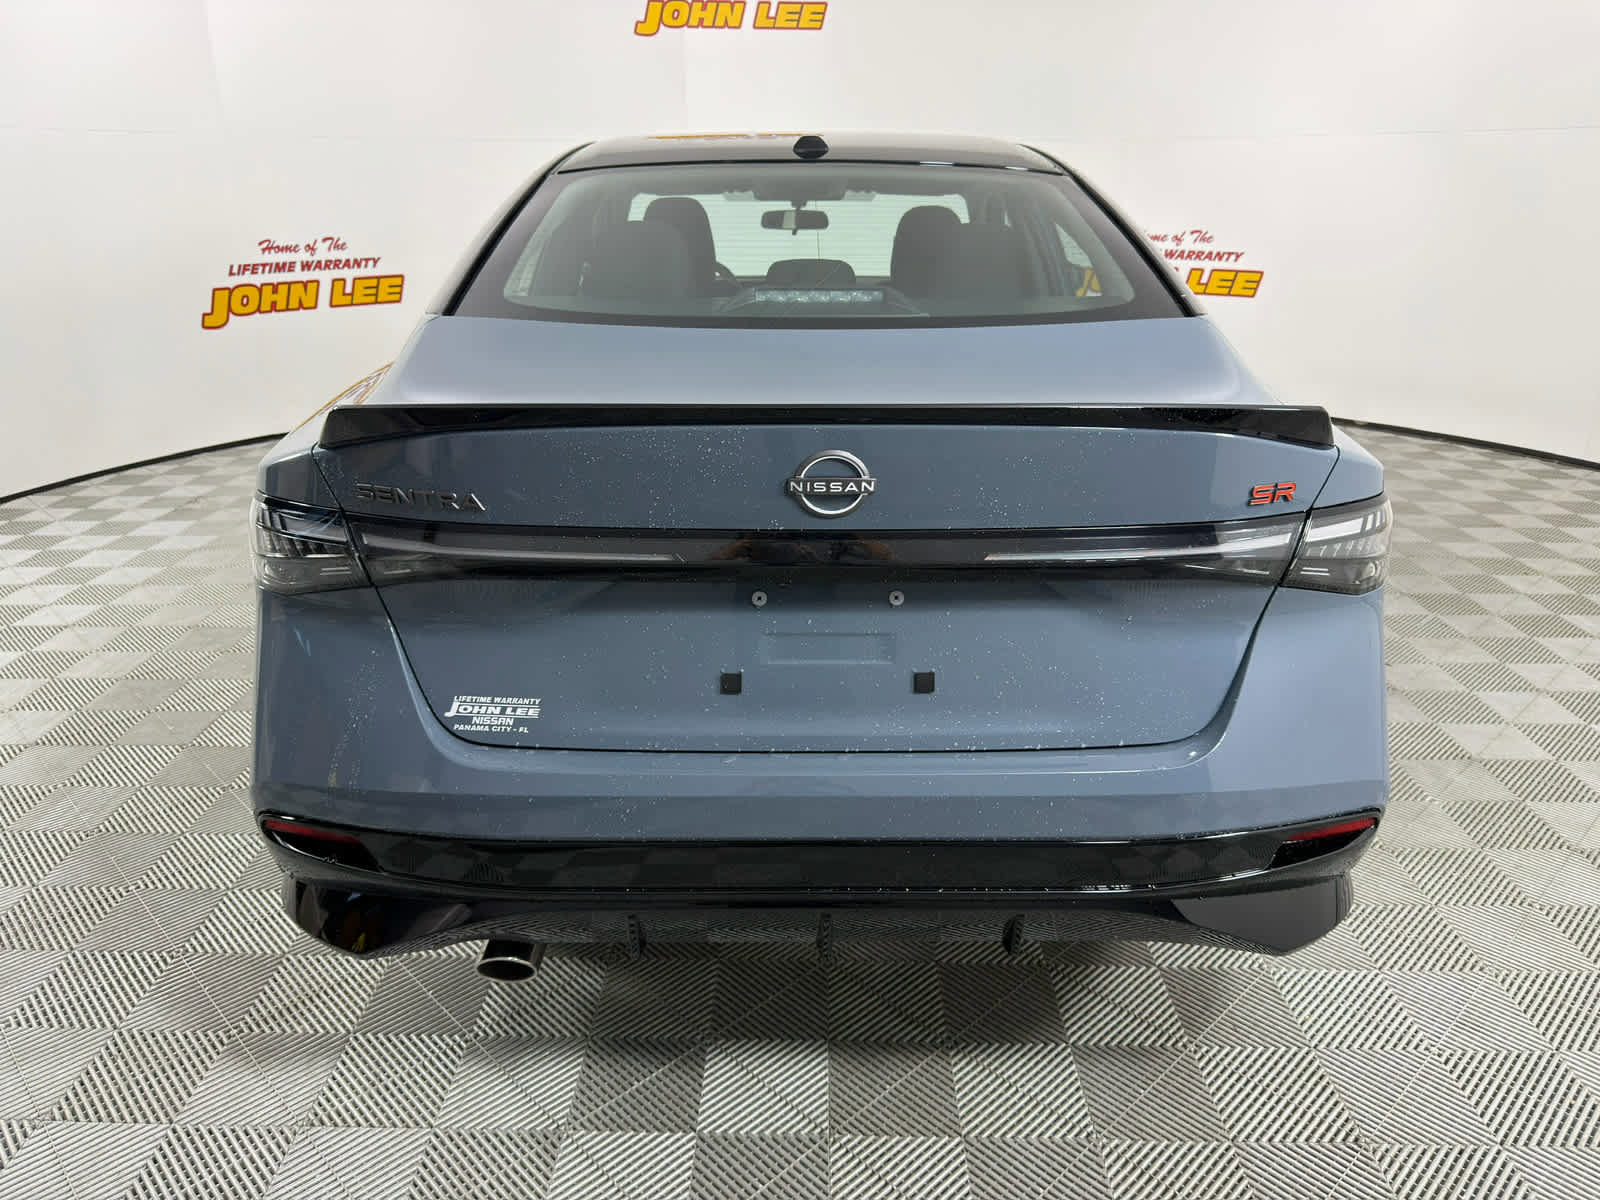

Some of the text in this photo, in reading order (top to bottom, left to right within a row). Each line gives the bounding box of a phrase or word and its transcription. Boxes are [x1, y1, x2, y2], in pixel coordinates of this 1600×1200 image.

[634, 0, 828, 36] JOHN LEE
[258, 237, 348, 256] Home of The
[1171, 230, 1186, 247] of
[1190, 230, 1214, 244] The
[1164, 249, 1245, 262] WARRANTY
[228, 257, 381, 277] LIFETIME WARRANTY
[1186, 268, 1264, 298] LEE
[201, 274, 404, 329] JOHN LEE
[790, 481, 875, 492] NISSAN
[1248, 482, 1297, 506] SR
[356, 483, 486, 511] SENTRA
[454, 695, 541, 705] LIFETIME WARRANTY
[444, 701, 541, 718] JOHN LEE
[453, 724, 489, 732] PANAMA
[492, 725, 512, 733] CITY
[519, 726, 529, 734] FL
[472, 716, 514, 726] NISSAN
